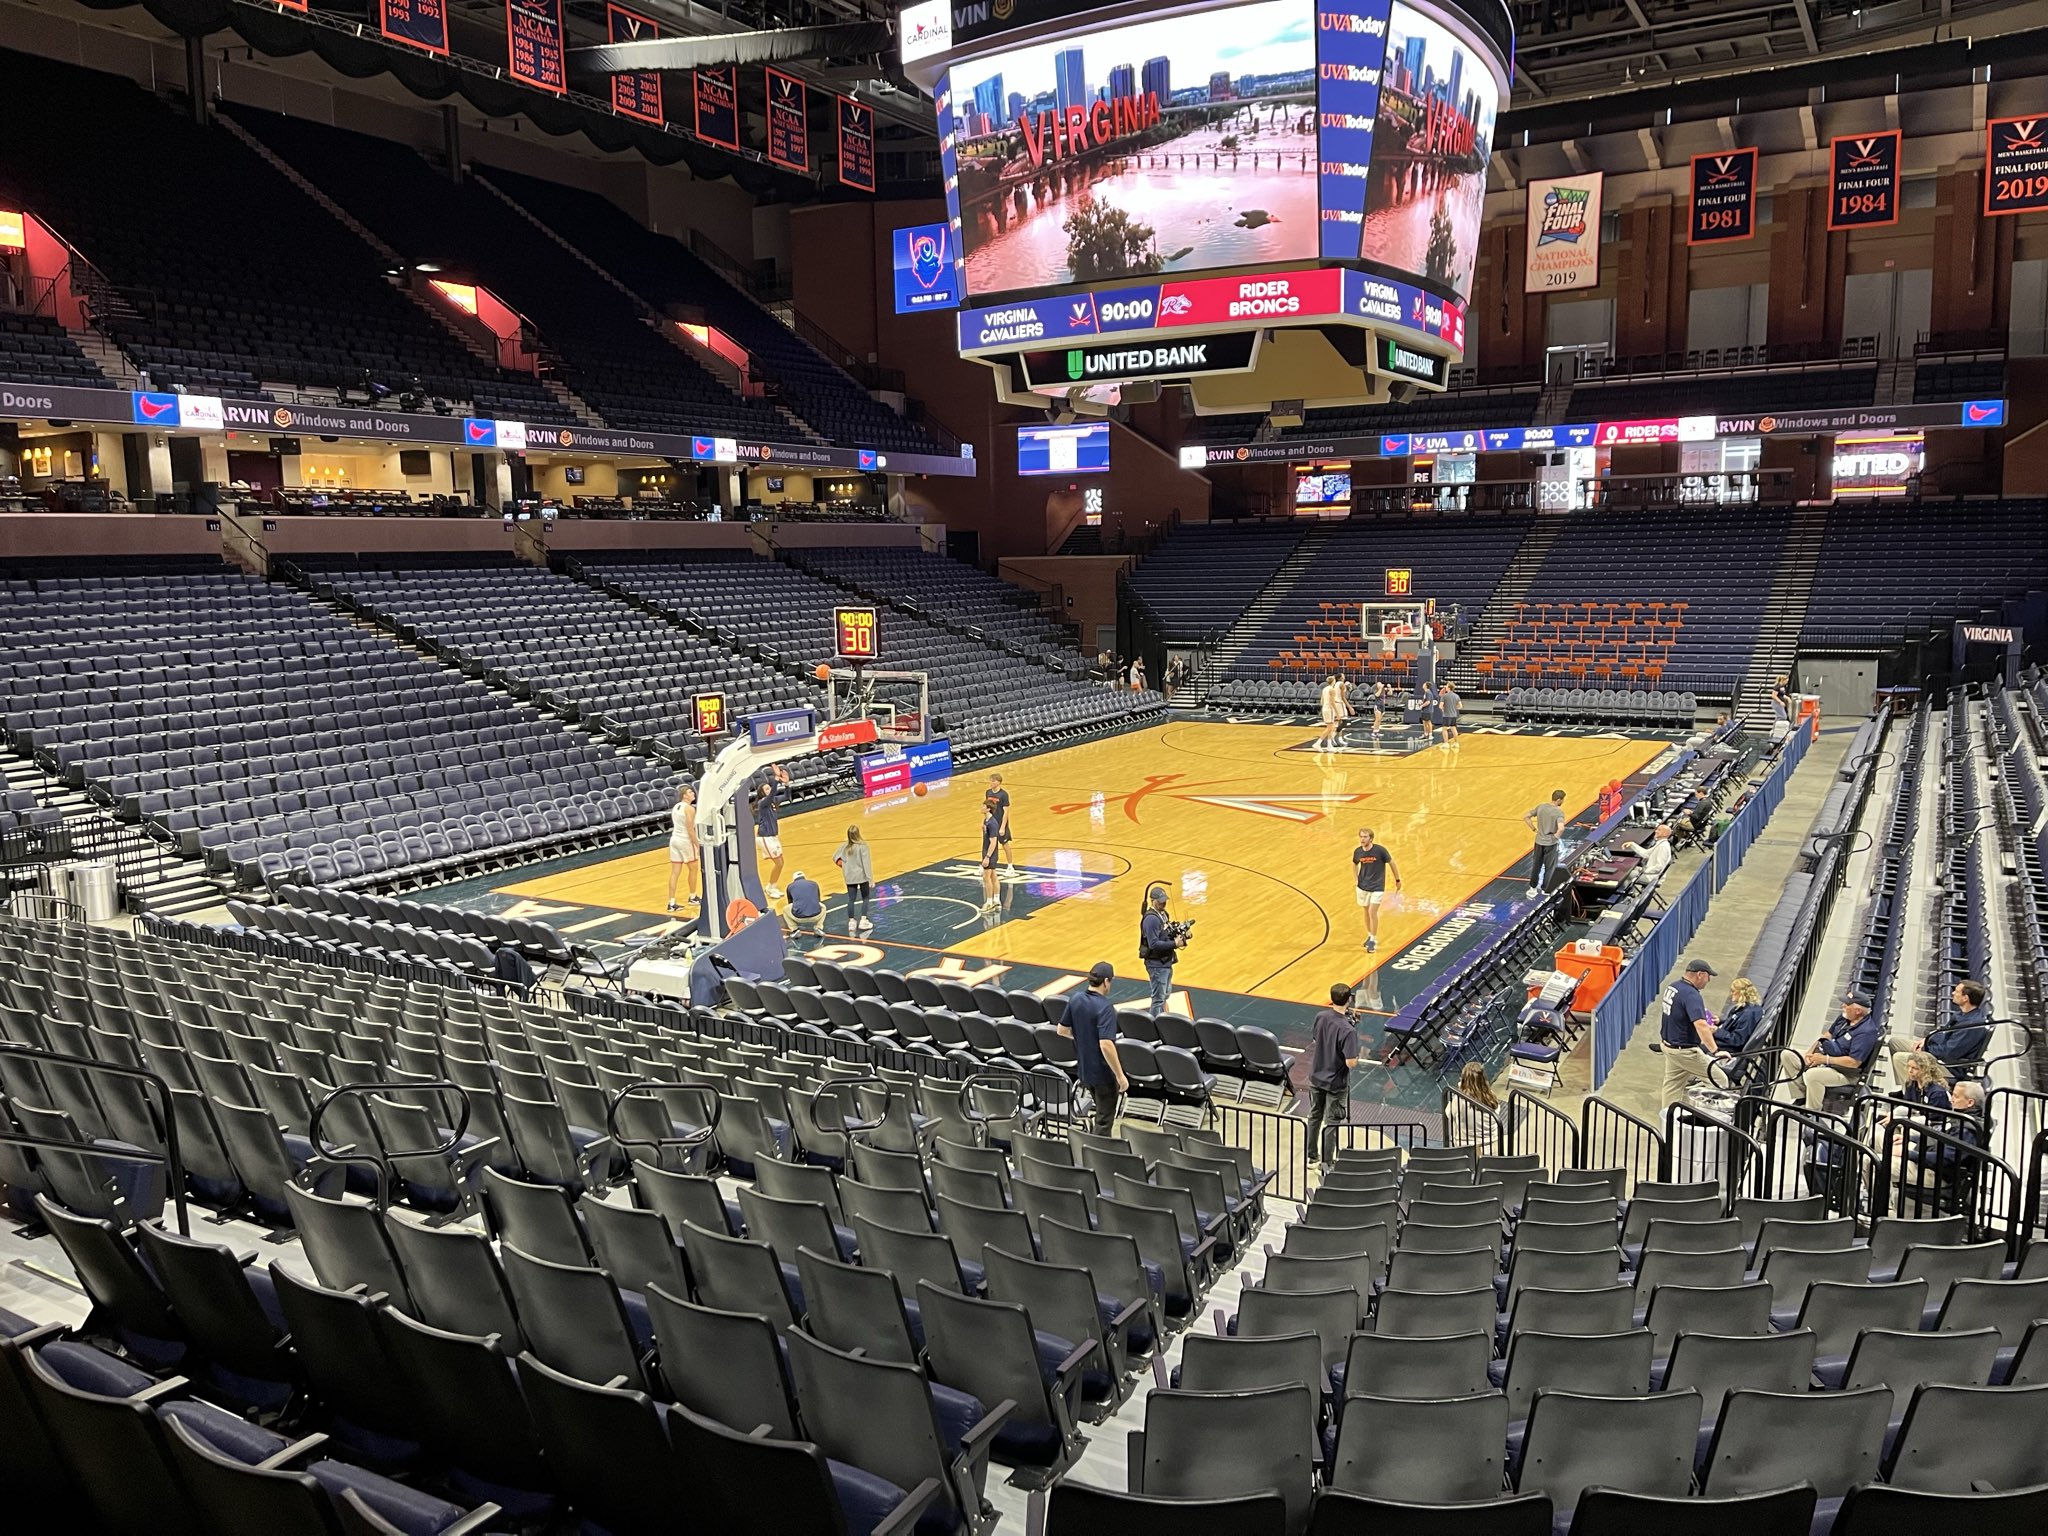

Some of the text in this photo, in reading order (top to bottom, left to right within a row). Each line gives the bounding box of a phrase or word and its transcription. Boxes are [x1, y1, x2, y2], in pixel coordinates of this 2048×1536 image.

[388, 5, 410, 22] 1993
[418, 3, 440, 19] 1992
[952, 3, 990, 29] VIN
[519, 14, 552, 38] NCAA
[906, 23, 949, 46] CARDINAL
[513, 24, 559, 47] TOURNAMENT
[515, 36, 534, 53] 1984
[516, 48, 534, 64] 1986
[516, 60, 560, 84] 1999 2001
[698, 90, 734, 110] TOURNAMENT
[703, 82, 729, 101] NCAA
[700, 101, 715, 115] 2018
[775, 108, 799, 127] NCAA
[1018, 91, 1160, 168] VIRGINIA
[846, 133, 867, 150] NCAA
[2015, 147, 2048, 157] BASKETBAL
[1995, 164, 2024, 175] FINAL
[1838, 177, 1890, 190] FINAL FOUR
[1996, 176, 2048, 200] 2019
[1697, 193, 1747, 207] FINAL FOUR
[1840, 192, 1887, 215] 1984
[1547, 201, 1584, 218] FINAL
[1543, 214, 1582, 231] FOUR
[1700, 208, 1741, 231] 1981
[1530, 256, 1593, 271] CHAMPIONS
[1536, 248, 1589, 262] NATIONAL
[1546, 271, 1577, 286] 2019
[1239, 280, 1289, 299] RIDER
[1363, 281, 1399, 302] VIRGINIA
[1101, 299, 1153, 322] 90:00
[1229, 297, 1300, 317] BRONCS
[1359, 298, 1402, 321] CAVALIERS
[1425, 304, 1442, 327] 90:00
[984, 308, 1038, 326] VIRGINIA
[980, 322, 1044, 343] CAVALIERS
[1085, 345, 1207, 373] UNITED BANK
[1394, 348, 1434, 377] UNITED BANK
[3, 392, 52, 409] Doors
[290, 412, 346, 429] Windows
[349, 416, 373, 431] and
[375, 417, 410, 433] Doors
[1832, 414, 1856, 426] and
[1859, 412, 1897, 425] Doors
[1524, 428, 1554, 440] 90:00
[1606, 424, 1660, 439] 0 RIDER
[612, 436, 628, 448] and
[629, 437, 654, 450] Doors
[1288, 444, 1305, 456] and
[1307, 443, 1334, 455] Doors
[1426, 438, 1449, 449] UVA
[1463, 434, 1474, 448] 0
[799, 449, 811, 461] and
[812, 451, 831, 462] Doors
[209, 523, 220, 531] 112
[1388, 571, 1409, 580] 90:00
[1390, 579, 1407, 593] 30
[840, 612, 873, 627] 90:00
[845, 627, 871, 652] 30
[1963, 626, 2014, 643] VIRGINIA
[699, 698, 720, 712] 90:00
[703, 712, 718, 729] 30
[775, 720, 801, 734] CITGO
[1456, 902, 1496, 918] UVA
[1391, 917, 1477, 971] ORTHOPEDICS
